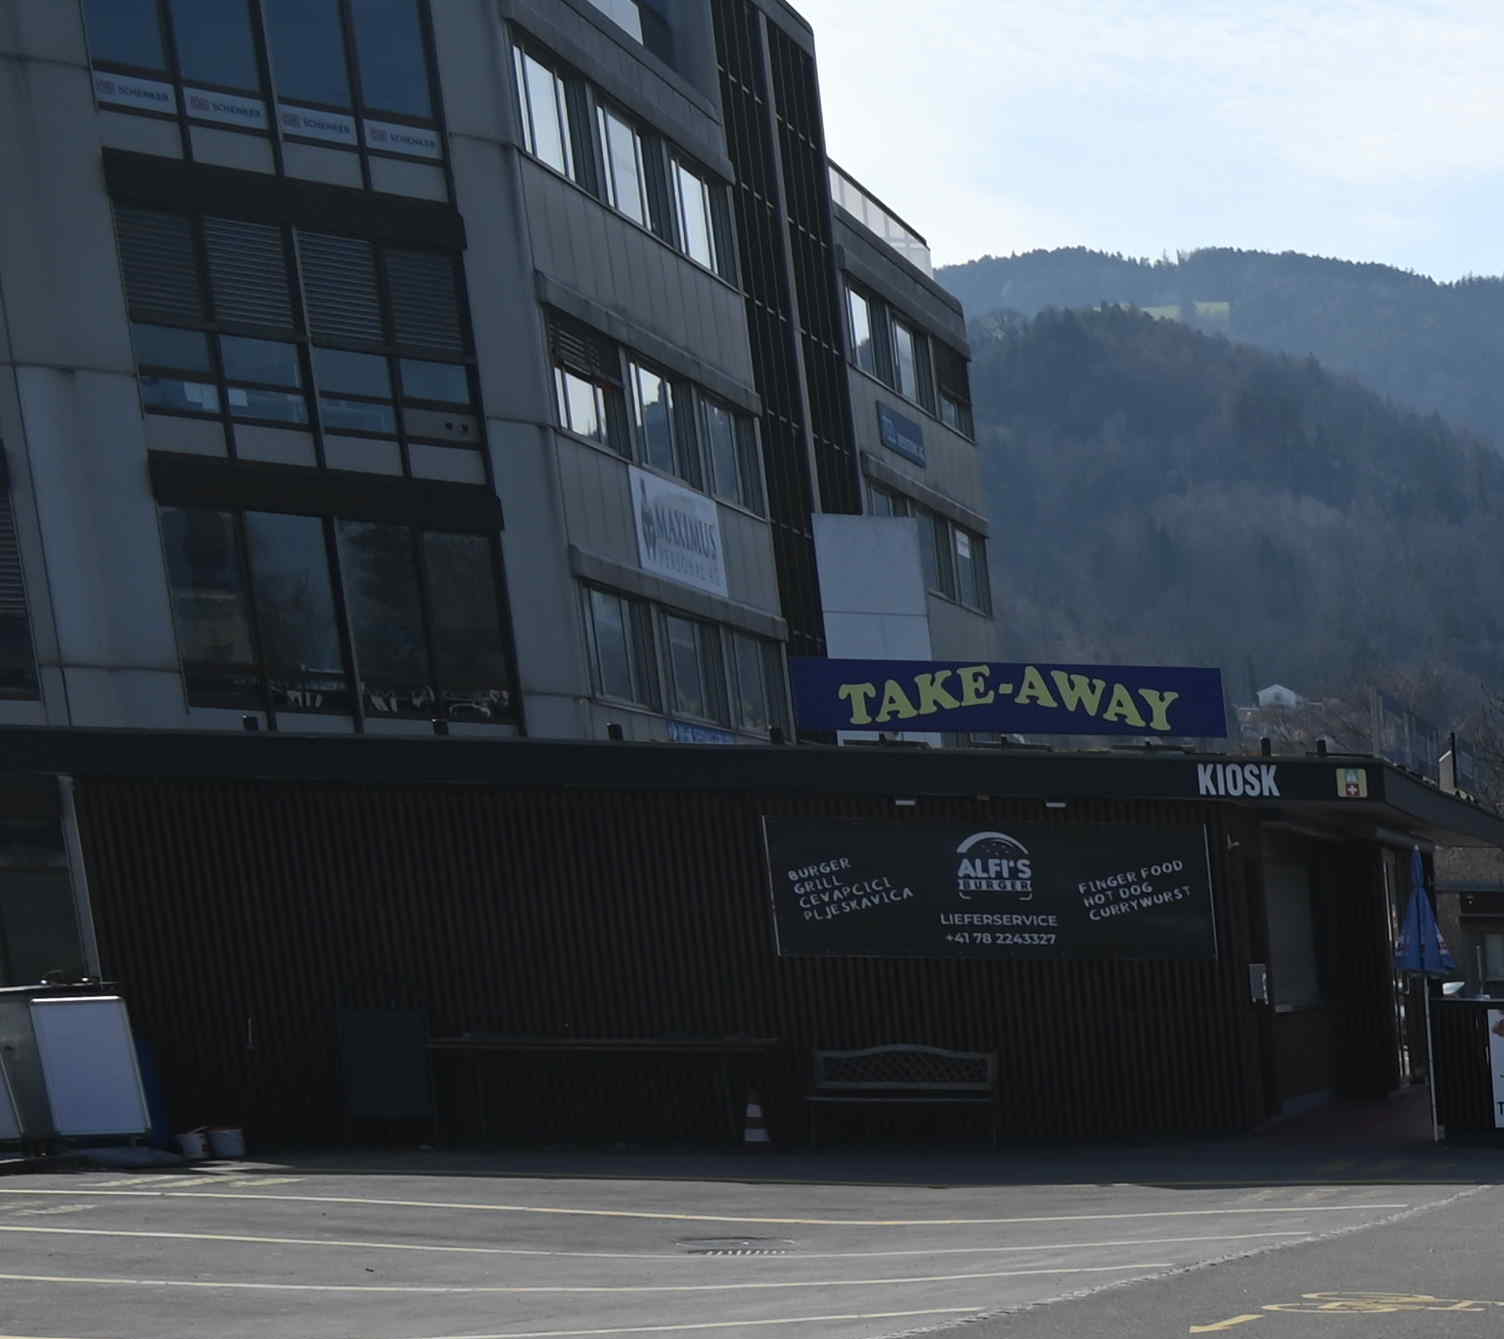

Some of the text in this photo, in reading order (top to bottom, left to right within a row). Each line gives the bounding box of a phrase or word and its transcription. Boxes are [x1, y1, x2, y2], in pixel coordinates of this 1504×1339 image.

[655, 504, 718, 560] MAXIMUS
[839, 665, 1179, 731] TAKE-AWAY
[1197, 763, 1280, 798] KIOSK
[787, 857, 852, 881] BURGER
[957, 859, 1031, 879] ALFI'S
[1078, 860, 1184, 894] FINGER FOOD
[793, 875, 842, 895] GRILL
[800, 876, 894, 908] CEVAPCICI
[958, 880, 1032, 891] BURGER
[1083, 882, 1153, 908] HOT DOG
[803, 888, 914, 921] PLJESKAVICA
[1089, 885, 1192, 921] CURRYWURST
[940, 912, 1058, 928] LIEFERSERVICE
[946, 932, 1056, 945] +41 78 2243327
